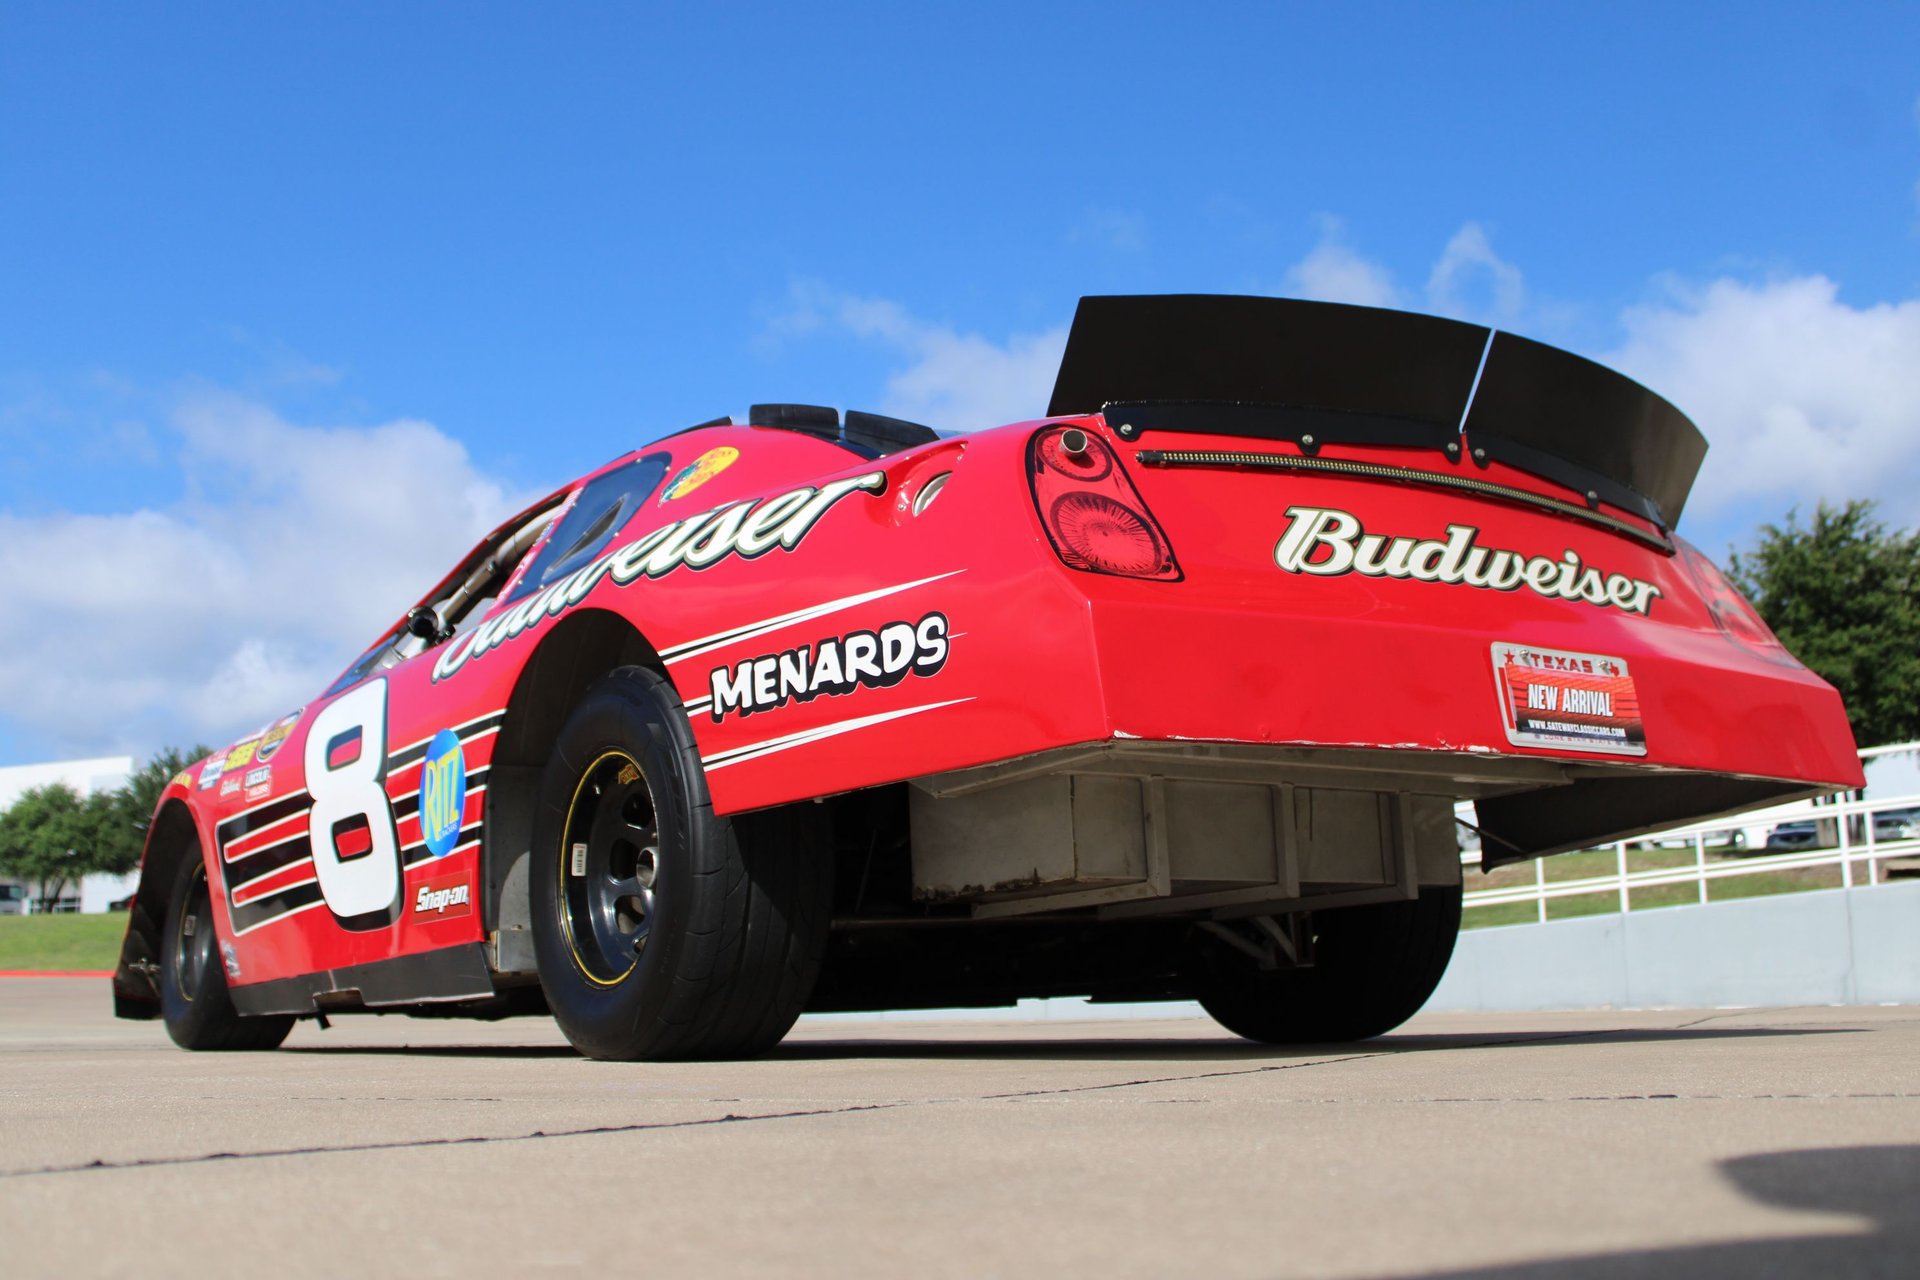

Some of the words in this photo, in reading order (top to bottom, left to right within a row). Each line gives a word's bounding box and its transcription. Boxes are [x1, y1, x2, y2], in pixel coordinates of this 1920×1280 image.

[1275, 506, 1662, 615] Budweiser
[711, 613, 949, 721] MENARDS
[1528, 684, 1558, 711] NEW
[1562, 688, 1613, 716] ARRIVAL
[1530, 653, 1593, 673] TEXAS
[304, 676, 404, 928] 8
[423, 746, 460, 842] RITZ
[415, 883, 470, 914] Snap-on
